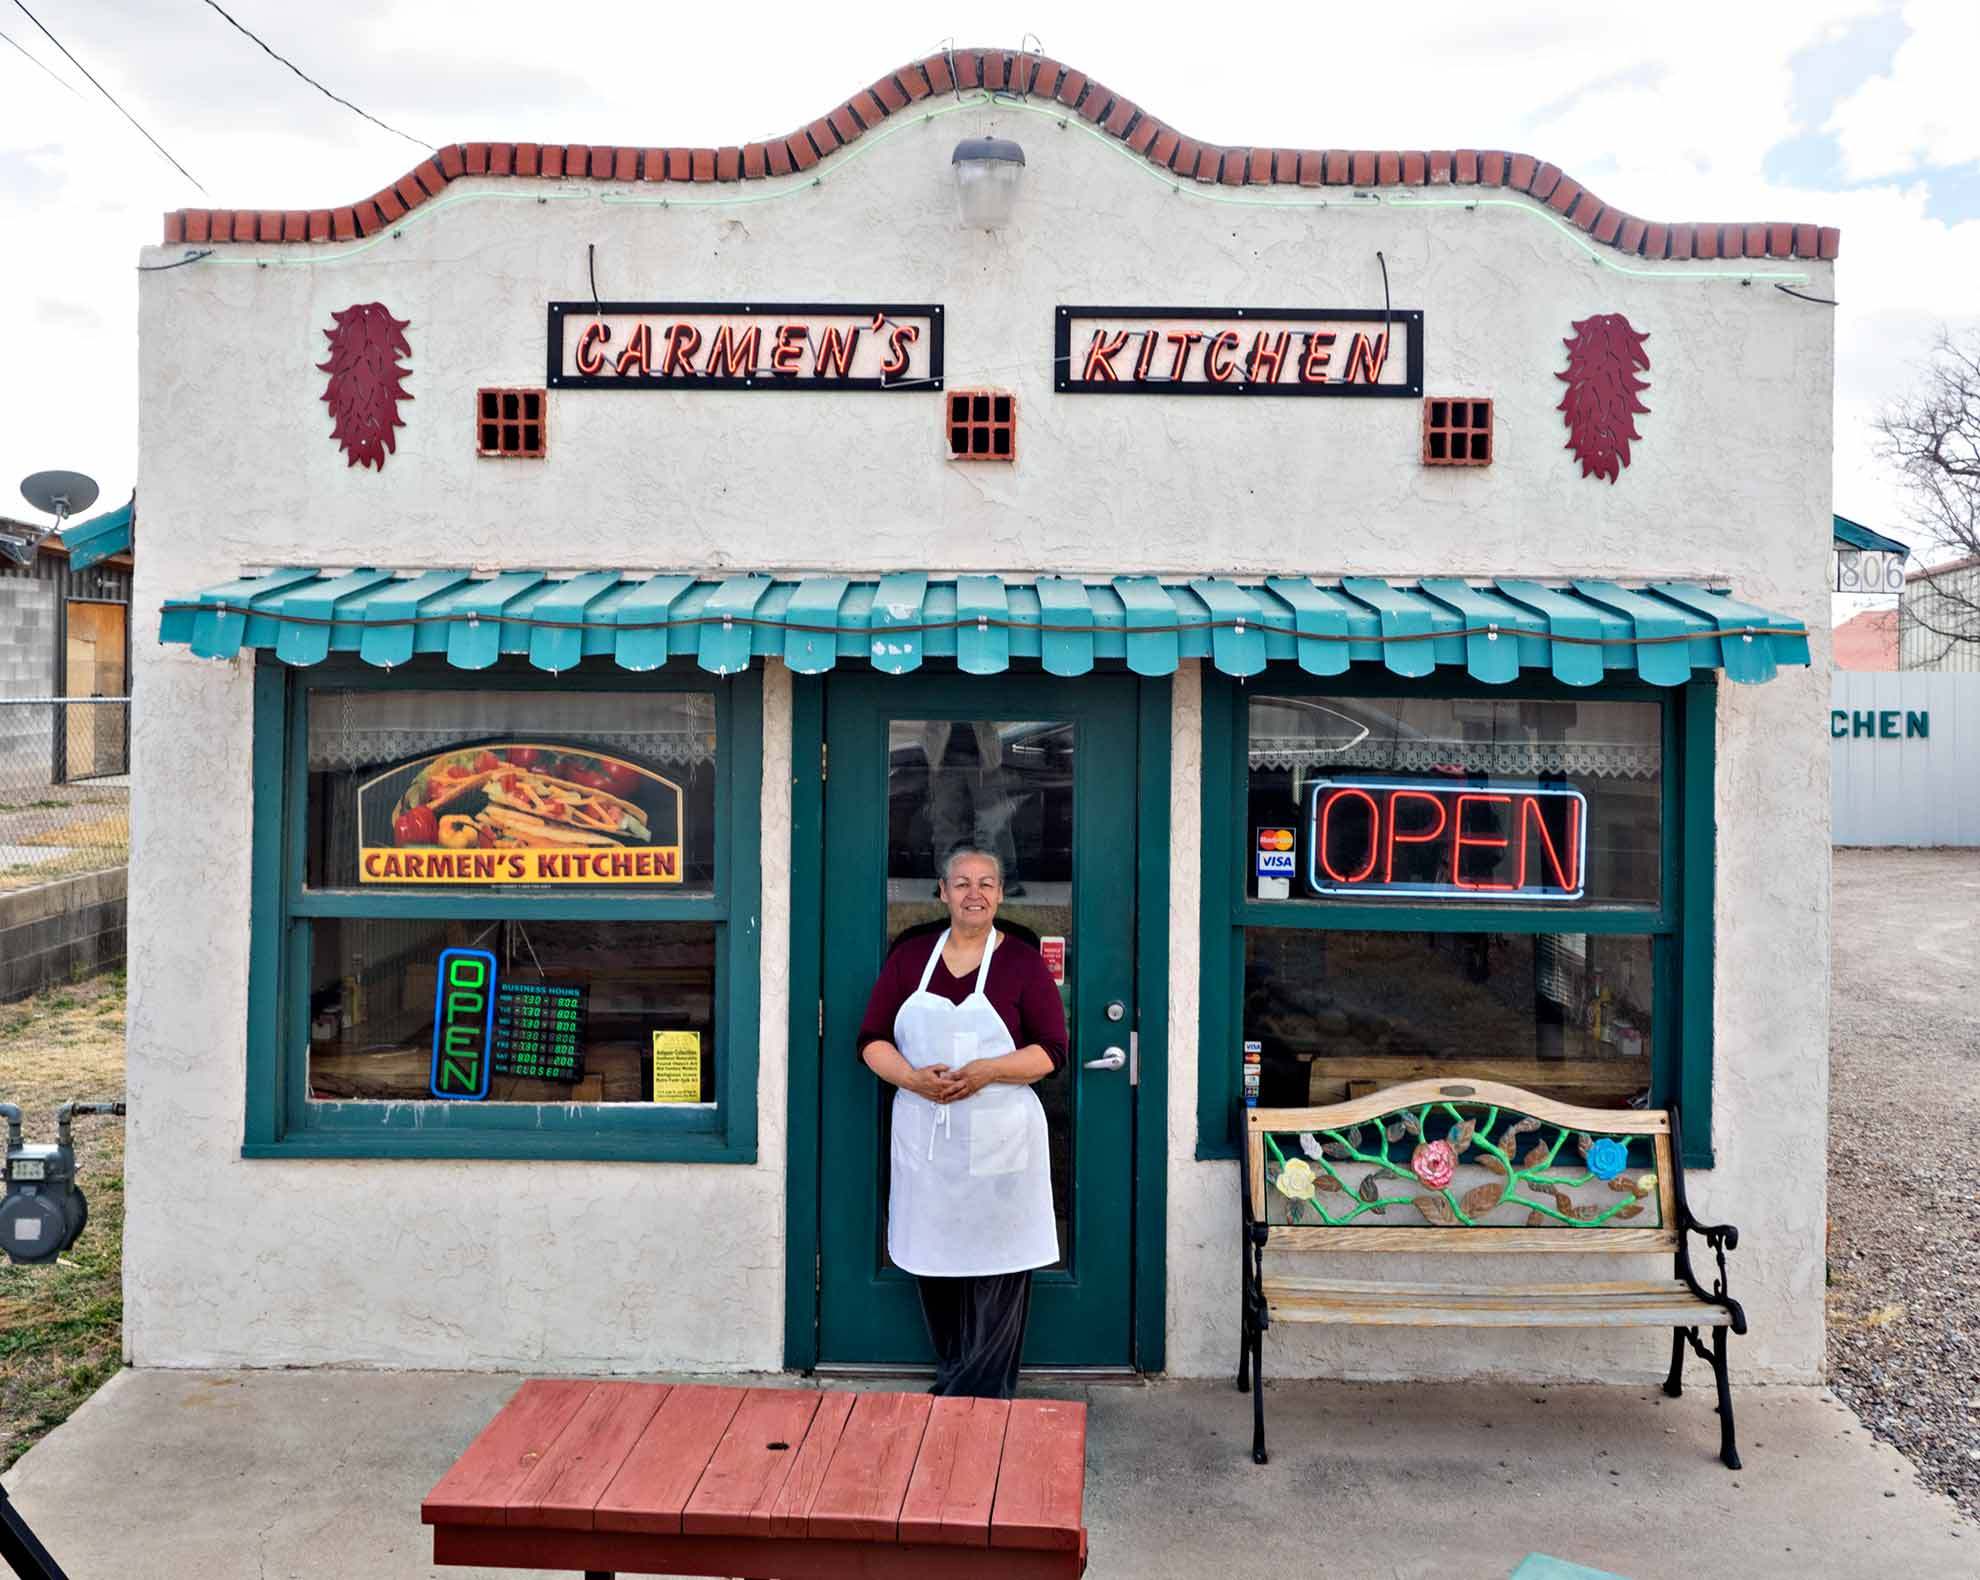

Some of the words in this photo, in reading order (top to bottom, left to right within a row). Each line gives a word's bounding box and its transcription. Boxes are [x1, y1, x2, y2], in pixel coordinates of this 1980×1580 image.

[576, 313, 920, 377] CARMEN'S
[1083, 328, 1388, 384] KITCHEN
[1825, 552, 1904, 589] 806
[1831, 709, 1929, 739] CHEN
[1321, 787, 1579, 892] OPEN
[364, 853, 527, 879] CARMEN'S
[537, 851, 676, 878] KITCHEN
[1262, 855, 1292, 867] VISA
[501, 984, 546, 994] BUSINESS
[548, 986, 580, 997] HOURS
[441, 959, 485, 1092] OPEN
